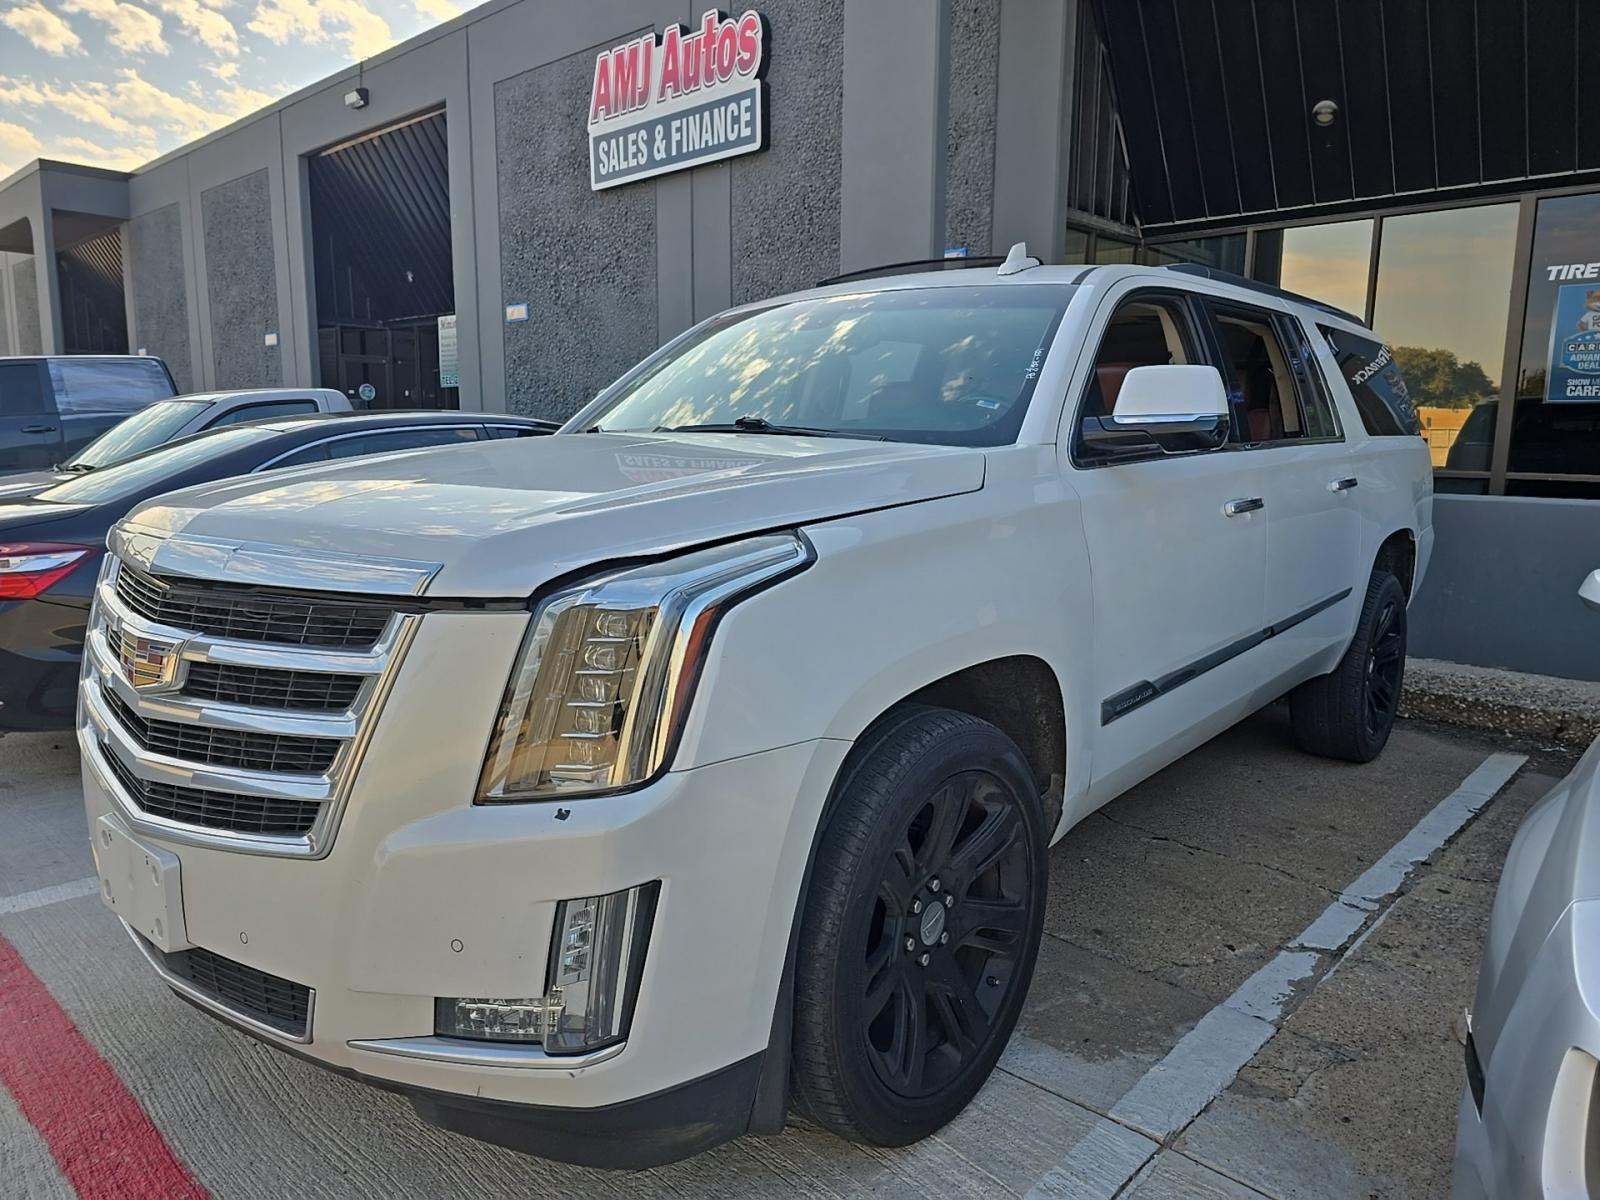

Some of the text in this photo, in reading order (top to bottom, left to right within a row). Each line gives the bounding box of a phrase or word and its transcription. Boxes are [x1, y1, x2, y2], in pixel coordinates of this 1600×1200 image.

[591, 14, 758, 124] AMJ Autos
[599, 98, 752, 175] SALES & FINANCE
[1547, 263, 1600, 280] TIRE
